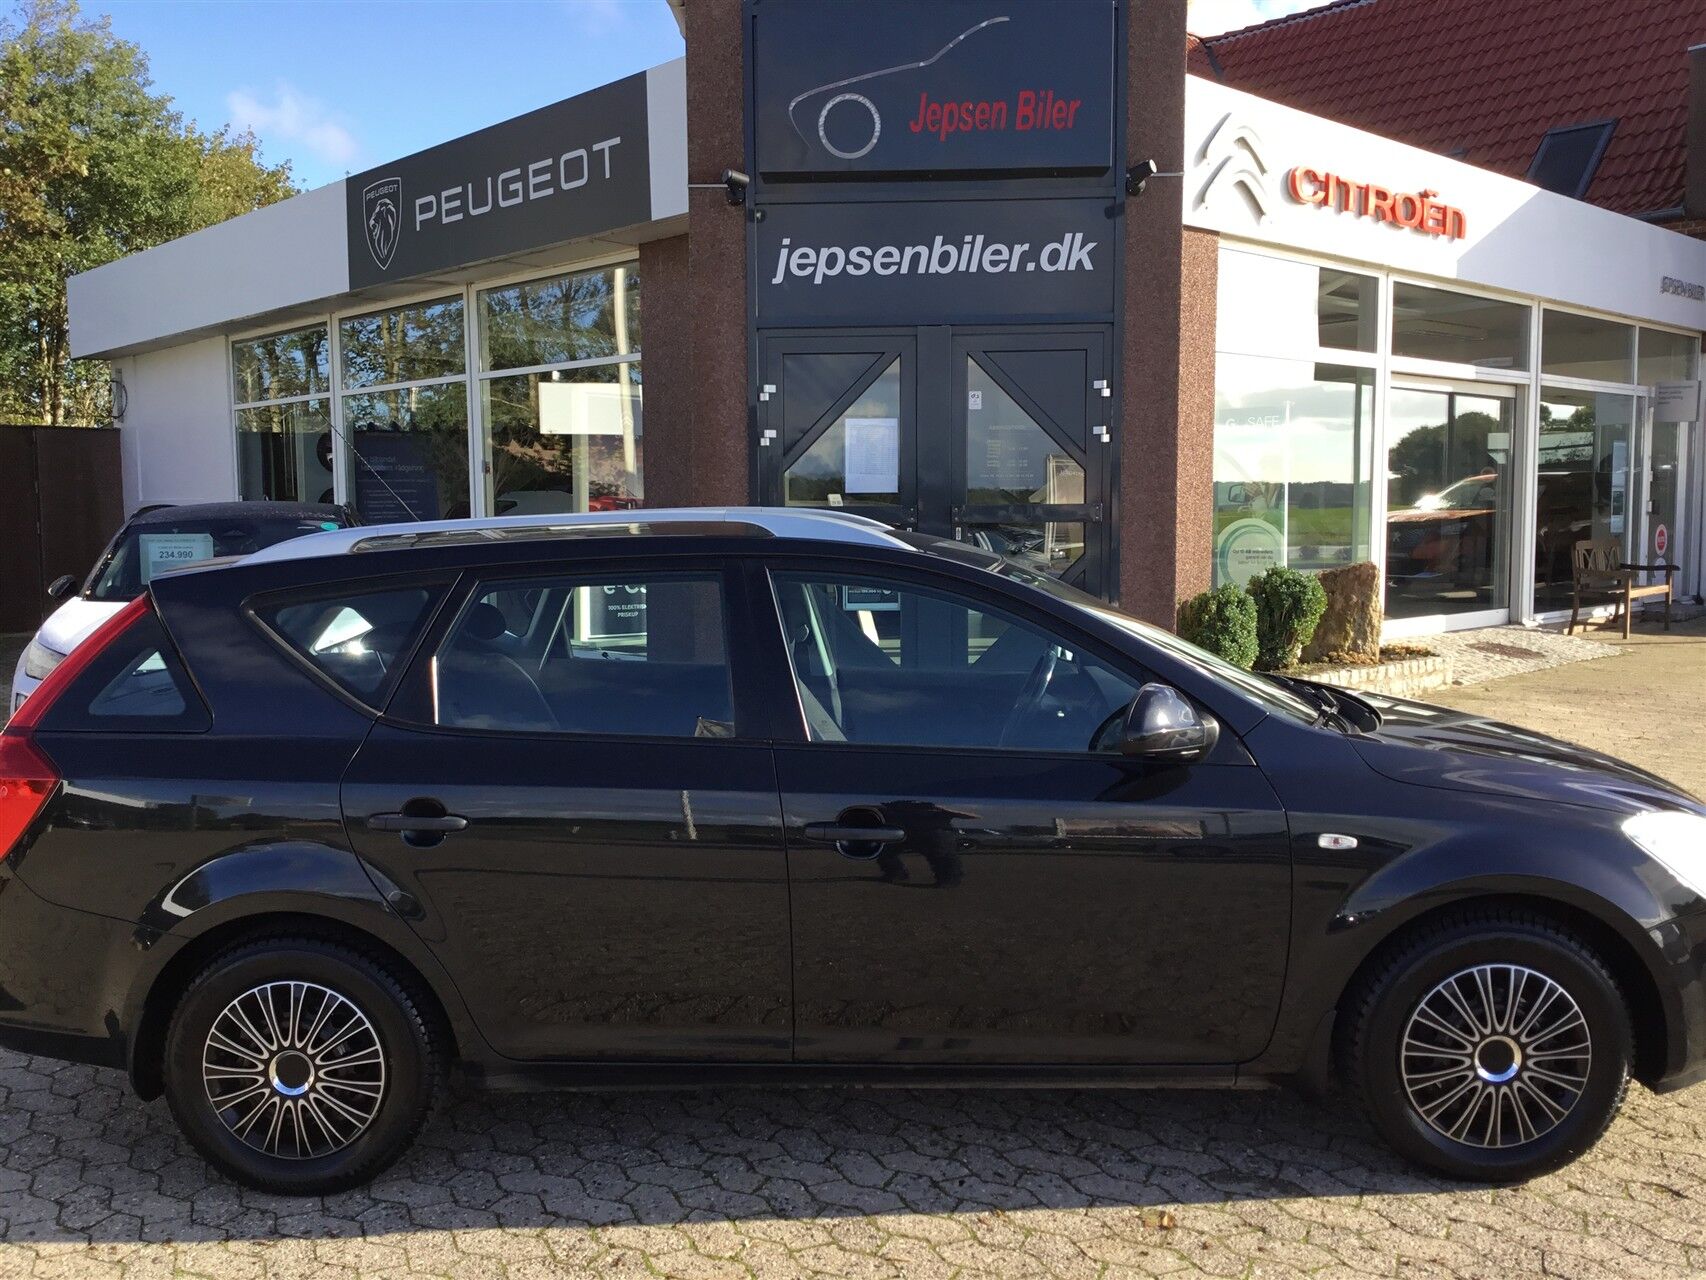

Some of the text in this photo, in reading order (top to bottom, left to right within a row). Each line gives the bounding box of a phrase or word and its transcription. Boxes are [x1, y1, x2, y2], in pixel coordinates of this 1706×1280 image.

[909, 89, 1081, 141] Jepsen Biler
[366, 184, 398, 201] PEUGEOT
[415, 136, 621, 231] PEUGEOT
[772, 233, 1098, 285] jepsenbiler.dk
[159, 550, 194, 559] 234.990
